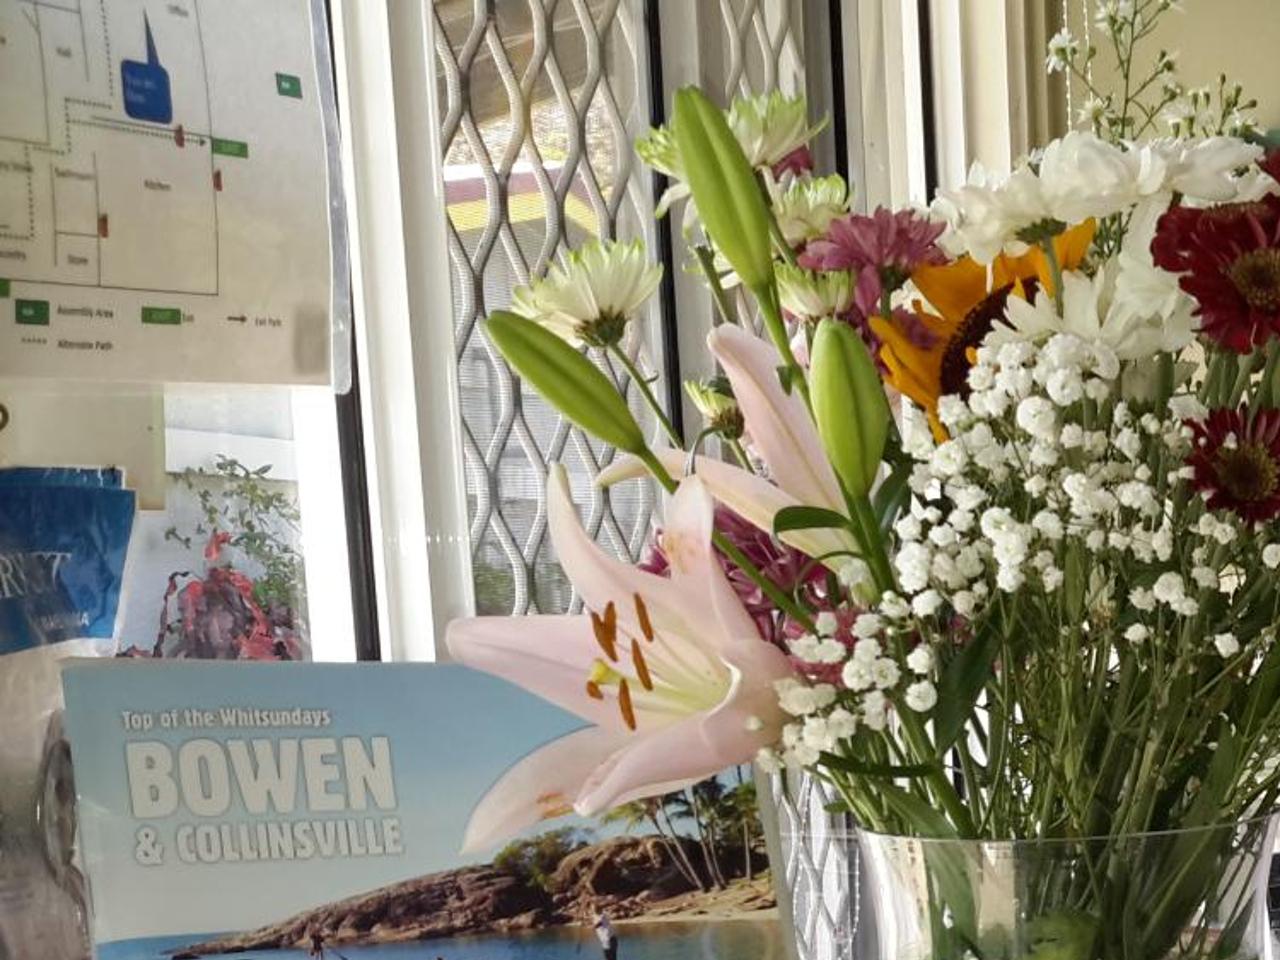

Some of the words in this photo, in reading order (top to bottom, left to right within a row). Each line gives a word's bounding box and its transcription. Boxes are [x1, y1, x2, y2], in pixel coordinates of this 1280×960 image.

[122, 710, 153, 730] Top
[161, 709, 178, 727] of
[184, 709, 216, 727] the
[217, 707, 332, 728] Whitsundays
[126, 736, 398, 818] BOWEN
[135, 826, 164, 866] &
[177, 819, 404, 864] COLLINSVILLE
